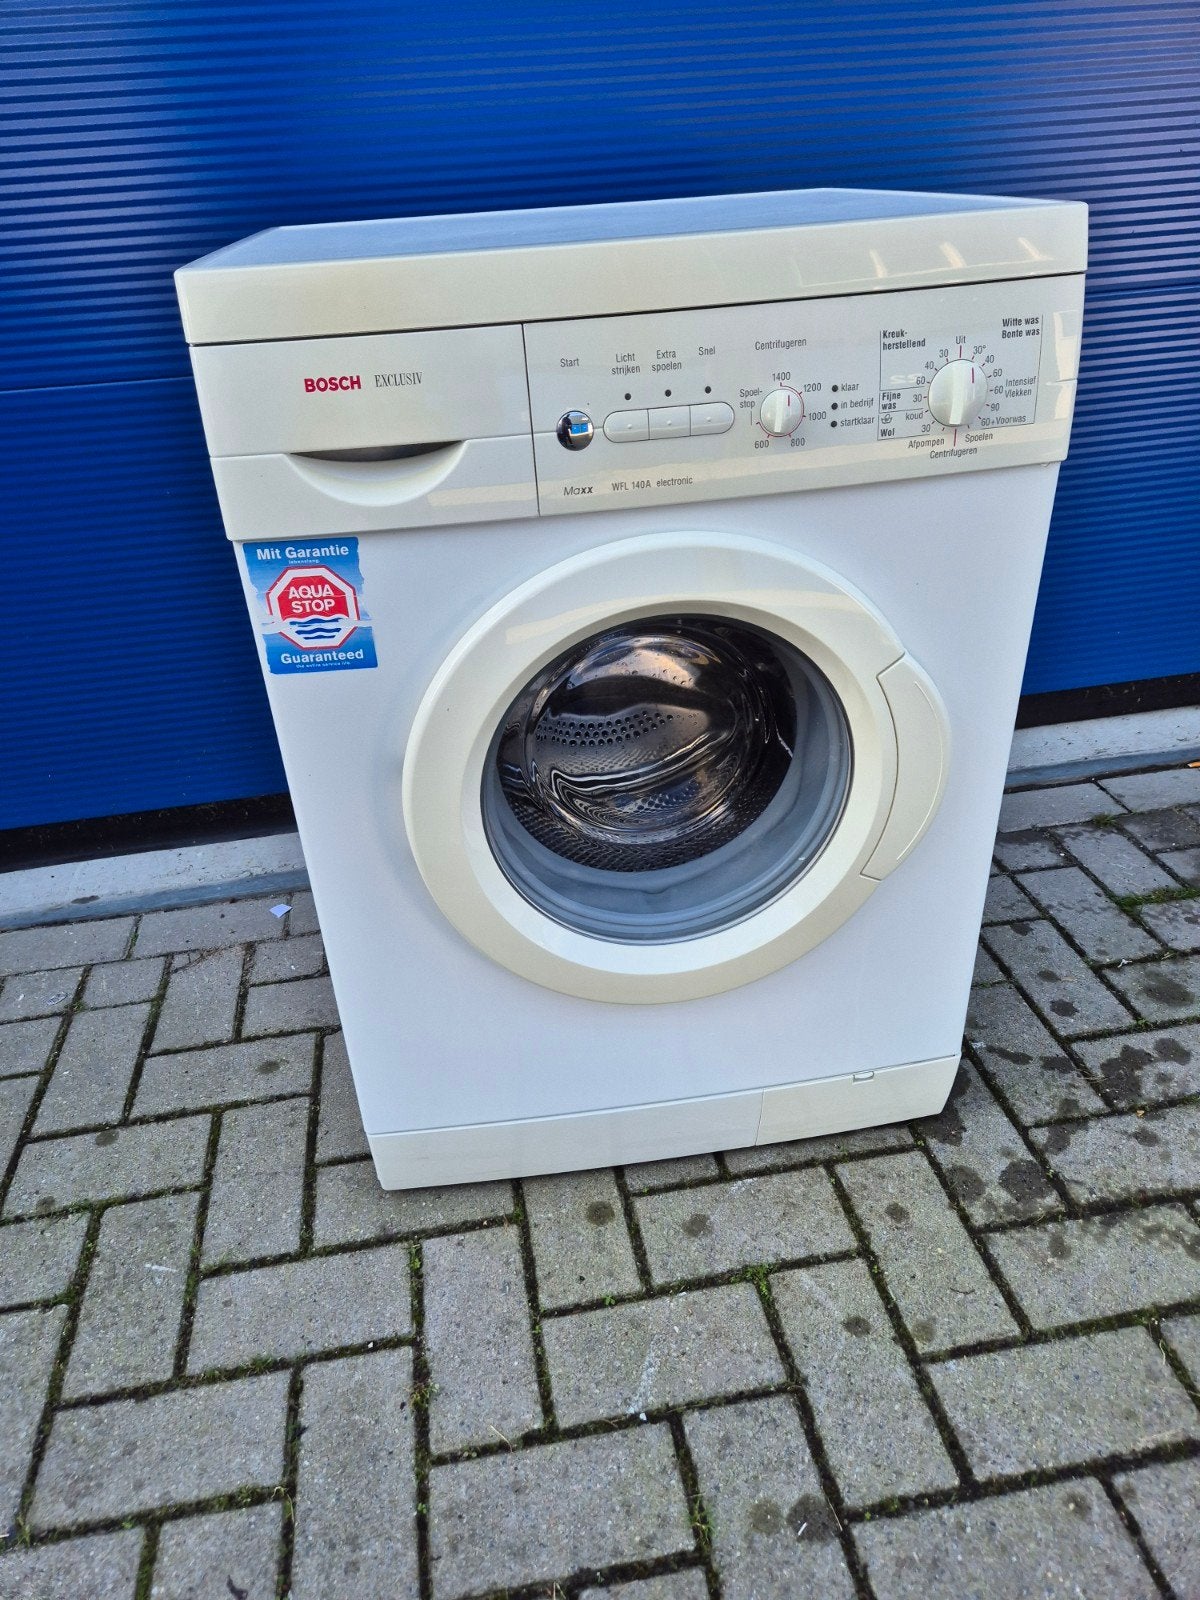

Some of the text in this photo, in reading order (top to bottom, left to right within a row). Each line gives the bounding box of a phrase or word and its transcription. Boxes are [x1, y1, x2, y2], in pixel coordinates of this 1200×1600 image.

[1002, 317, 1039, 327] Witte was
[883, 329, 908, 339] Kreuk-
[1002, 329, 1023, 339] Bonte
[755, 338, 806, 350] Centrifugeren
[883, 339, 925, 350] herstellend
[956, 336, 965, 344] Uit
[657, 350, 676, 359] Extra
[699, 346, 715, 355] Snel
[939, 349, 948, 357] 30
[616, 353, 635, 362] Licht
[985, 355, 994, 363] 40
[560, 358, 579, 367] Start
[652, 362, 681, 372] spoelen
[925, 361, 934, 369] 40
[612, 364, 640, 375] strijken
[993, 369, 1002, 377] 60
[772, 372, 790, 381] 1400
[916, 377, 926, 385] 60
[304, 372, 422, 392] BOSCH EXCLUSIV
[1006, 376, 1036, 387] Intensief
[804, 383, 821, 392] 1200
[841, 383, 859, 391] klaar
[994, 386, 1003, 394] 60
[740, 388, 762, 398] Spoel-
[882, 392, 901, 400] Fijne
[1005, 388, 1031, 398] Vlekken
[913, 394, 922, 402] 30
[740, 400, 755, 409] stop
[841, 398, 874, 409] in bedrijf
[882, 402, 896, 410] was
[991, 403, 999, 411] 90
[809, 412, 826, 420] 1000
[906, 410, 923, 420] koud
[840, 417, 875, 427] startklaar
[881, 428, 894, 437] Wol
[922, 424, 930, 433] 30
[965, 433, 993, 442] Spoelen
[755, 440, 769, 448] 600
[791, 438, 805, 447] 800
[908, 437, 944, 448] Afpompen
[930, 447, 977, 459] Centrifugeren
[564, 476, 693, 496] Maxx WFL 140A electronic
[257, 545, 349, 560] Mit Garantie
[288, 584, 334, 599] AQUA
[292, 599, 335, 613] STOP
[281, 649, 363, 664] Guaranteed
